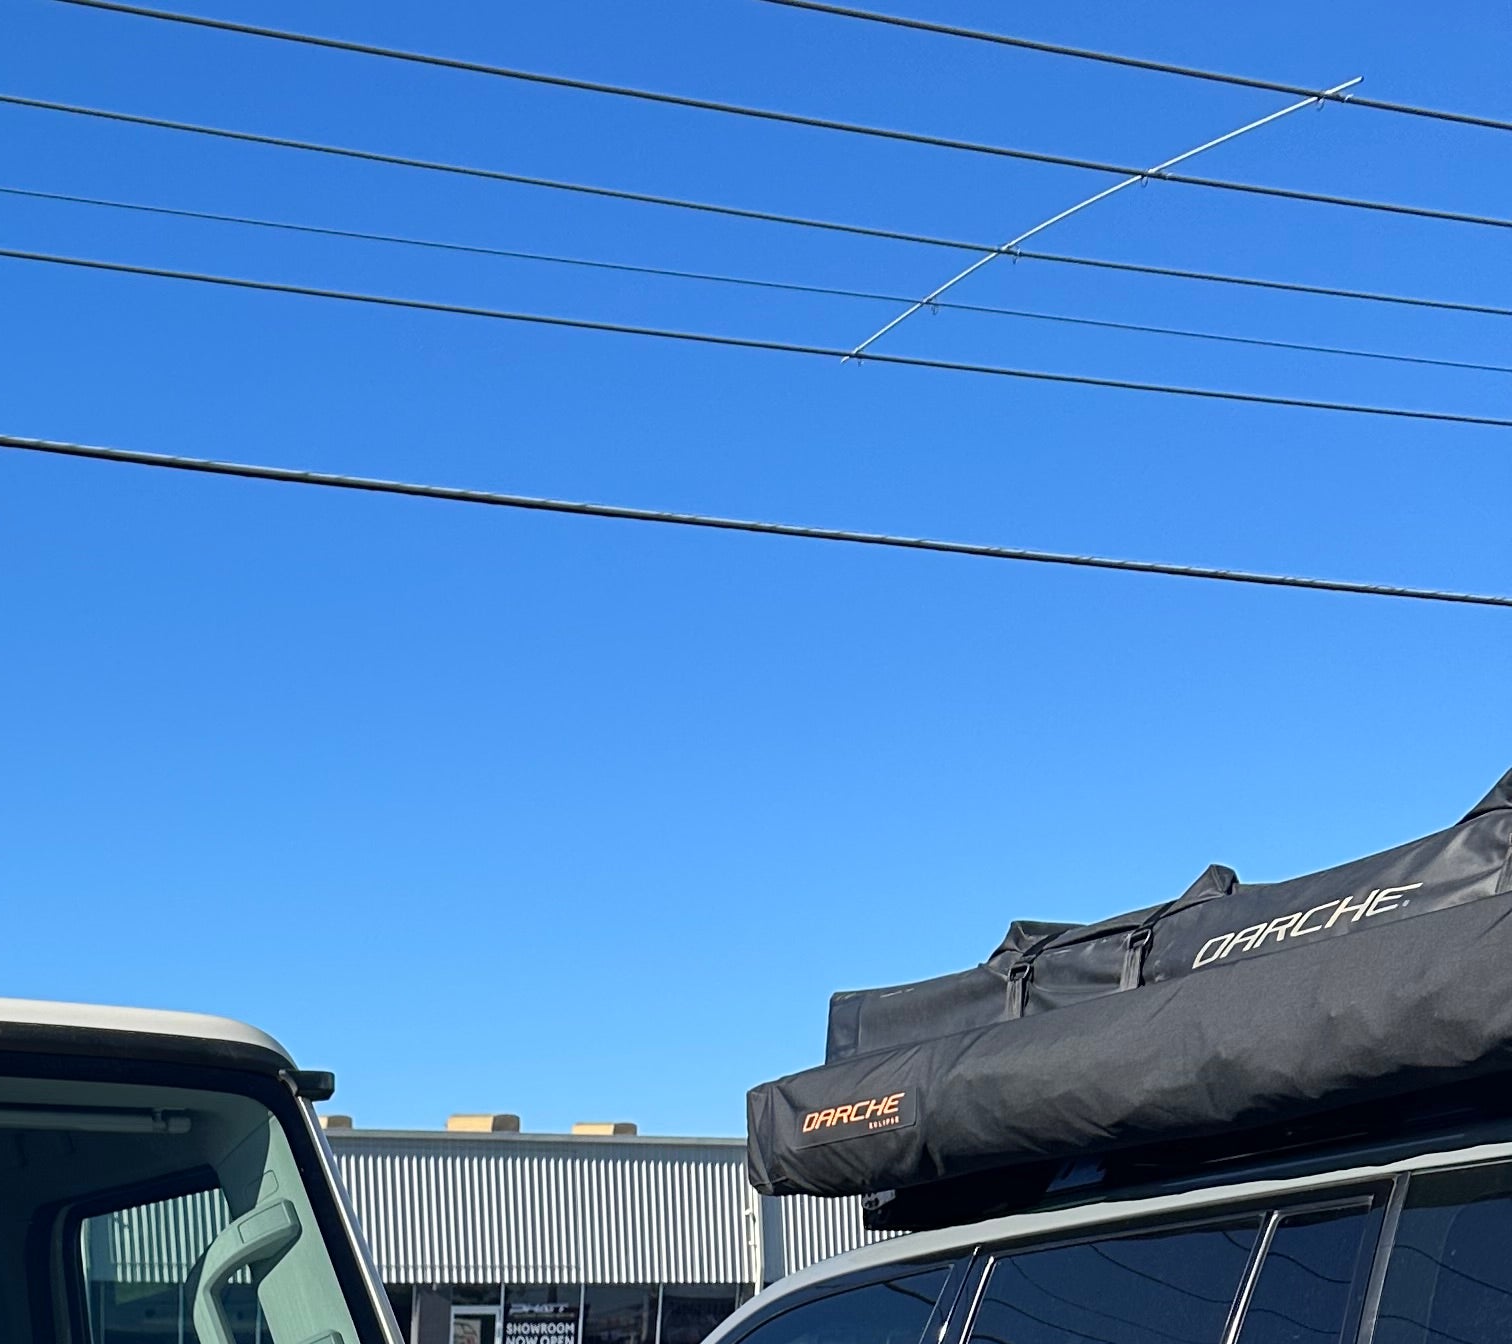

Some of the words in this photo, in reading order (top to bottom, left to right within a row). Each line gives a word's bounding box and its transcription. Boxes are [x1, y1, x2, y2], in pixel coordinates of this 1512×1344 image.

[1191, 882, 1424, 970] DARCHE
[802, 1092, 906, 1133] DARCHE
[506, 1322, 575, 1335] SHOWROOM
